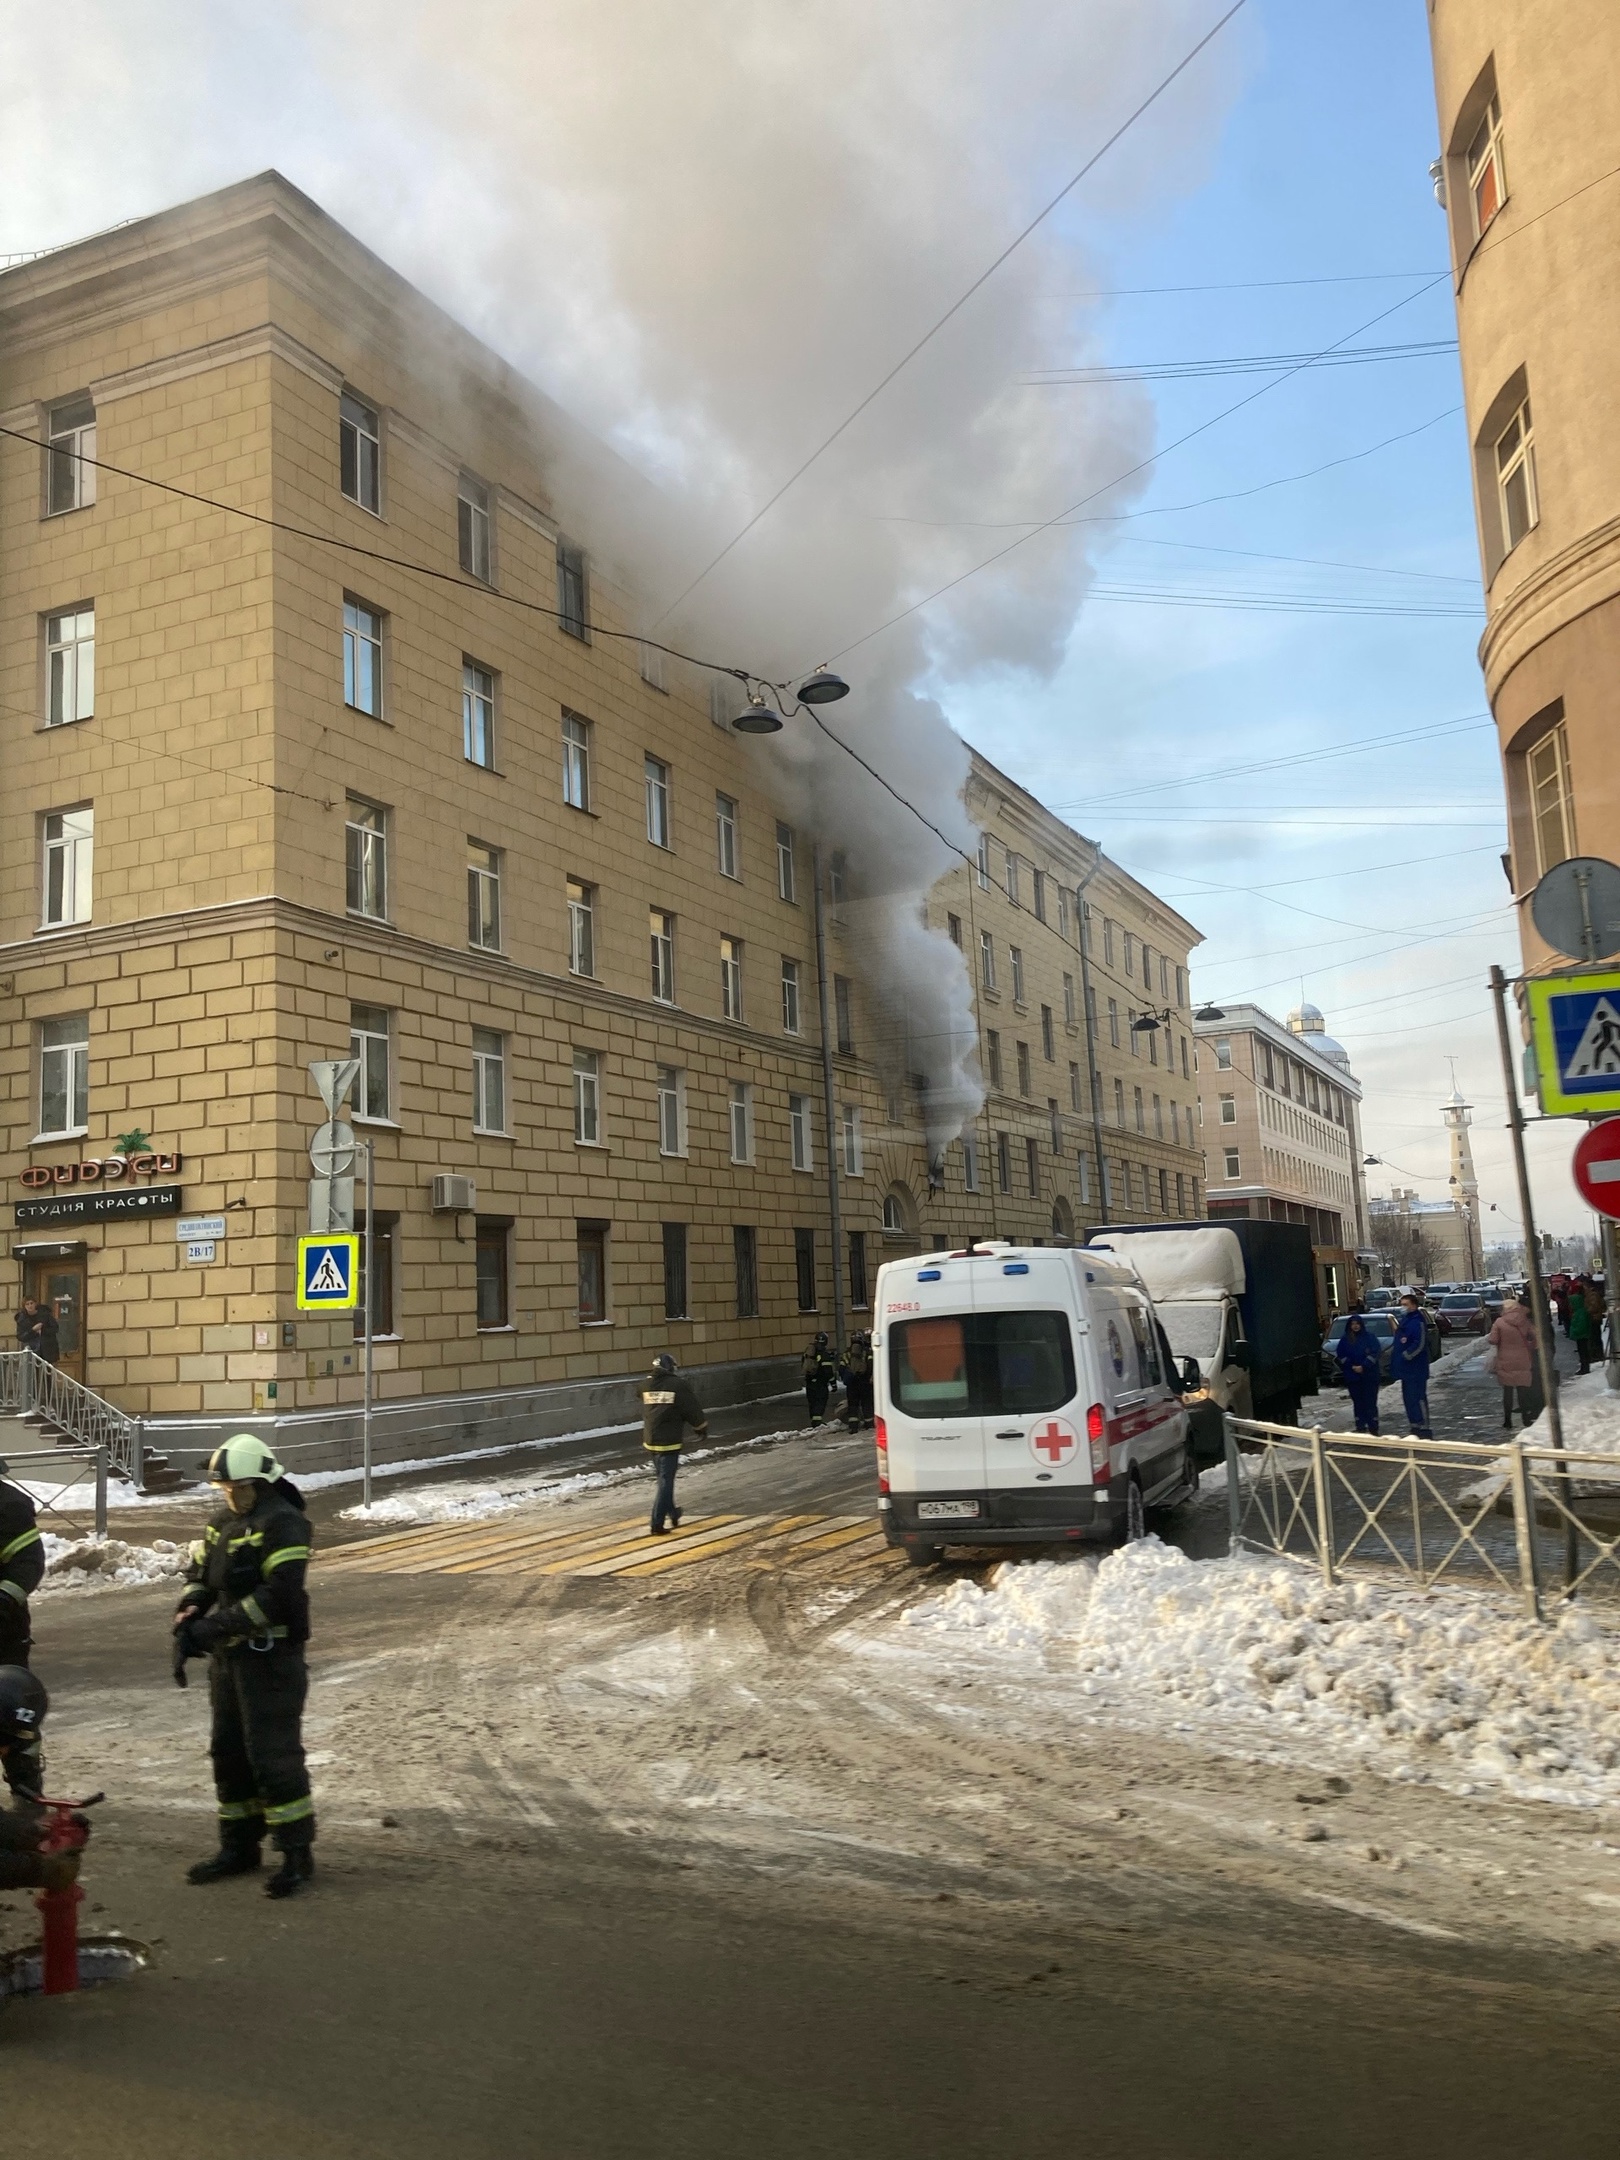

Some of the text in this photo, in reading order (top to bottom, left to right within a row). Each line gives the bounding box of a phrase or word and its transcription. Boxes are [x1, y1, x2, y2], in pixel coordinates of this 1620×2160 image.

[16, 1193, 173, 1218] СТУДИЯ КРАСОТЫ
[15, 1707, 36, 1723] 12
